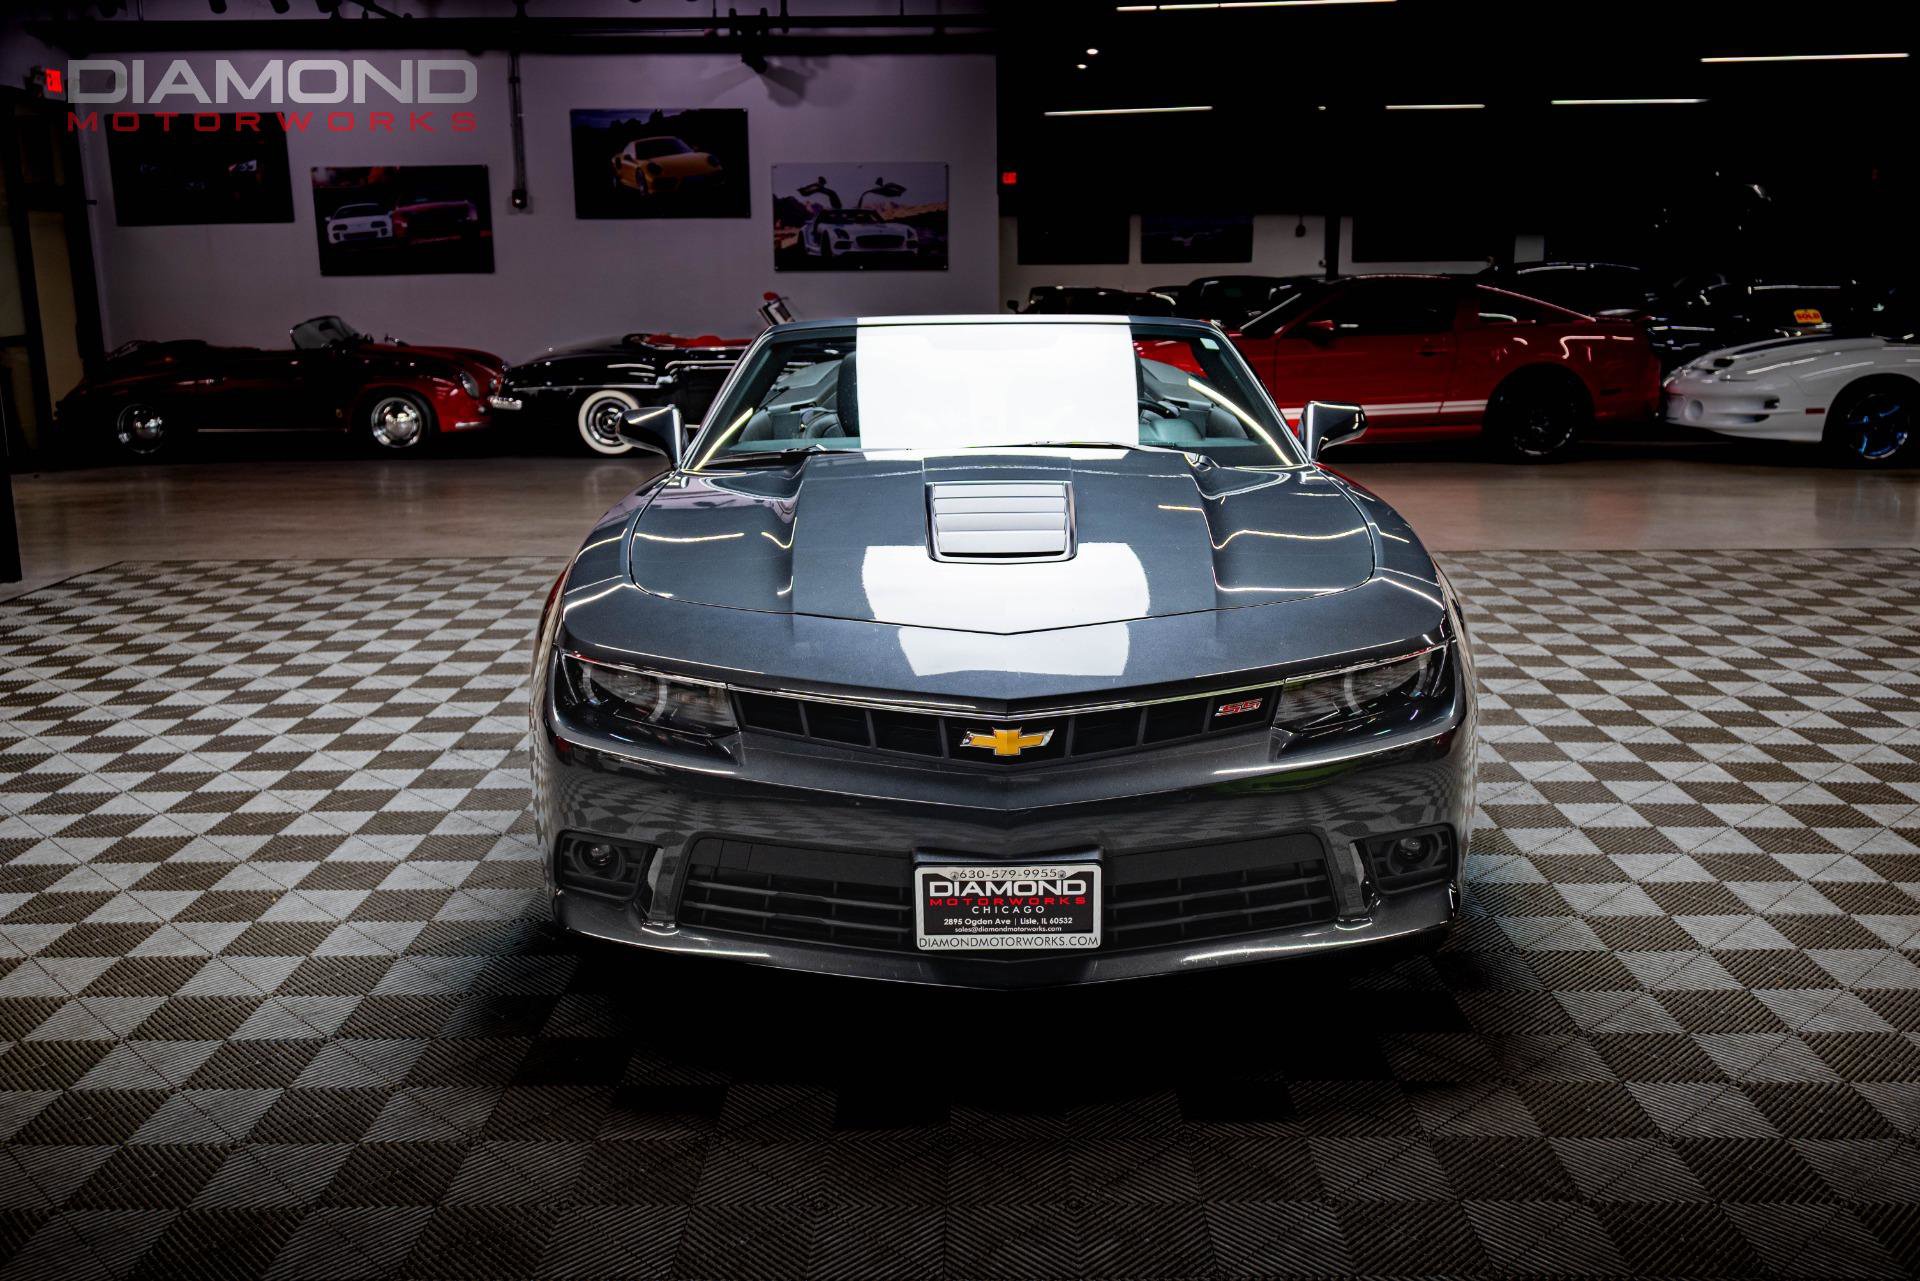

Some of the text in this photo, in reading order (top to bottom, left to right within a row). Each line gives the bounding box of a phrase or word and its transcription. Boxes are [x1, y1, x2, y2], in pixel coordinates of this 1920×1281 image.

[959, 868, 1057, 879] 630-579-9955
[929, 880, 1087, 897] DIAMOND
[929, 896, 1086, 906] MOTORWORKS
[971, 905, 1045, 914] CHICAGO
[943, 918, 963, 926] 2895
[964, 918, 993, 926] Ogden
[1020, 917, 1039, 925] Lisle,
[1041, 917, 1048, 925] IL
[1049, 917, 1073, 925] 60532
[919, 936, 1099, 948] DIAMONDMOTORWORKS.COM
